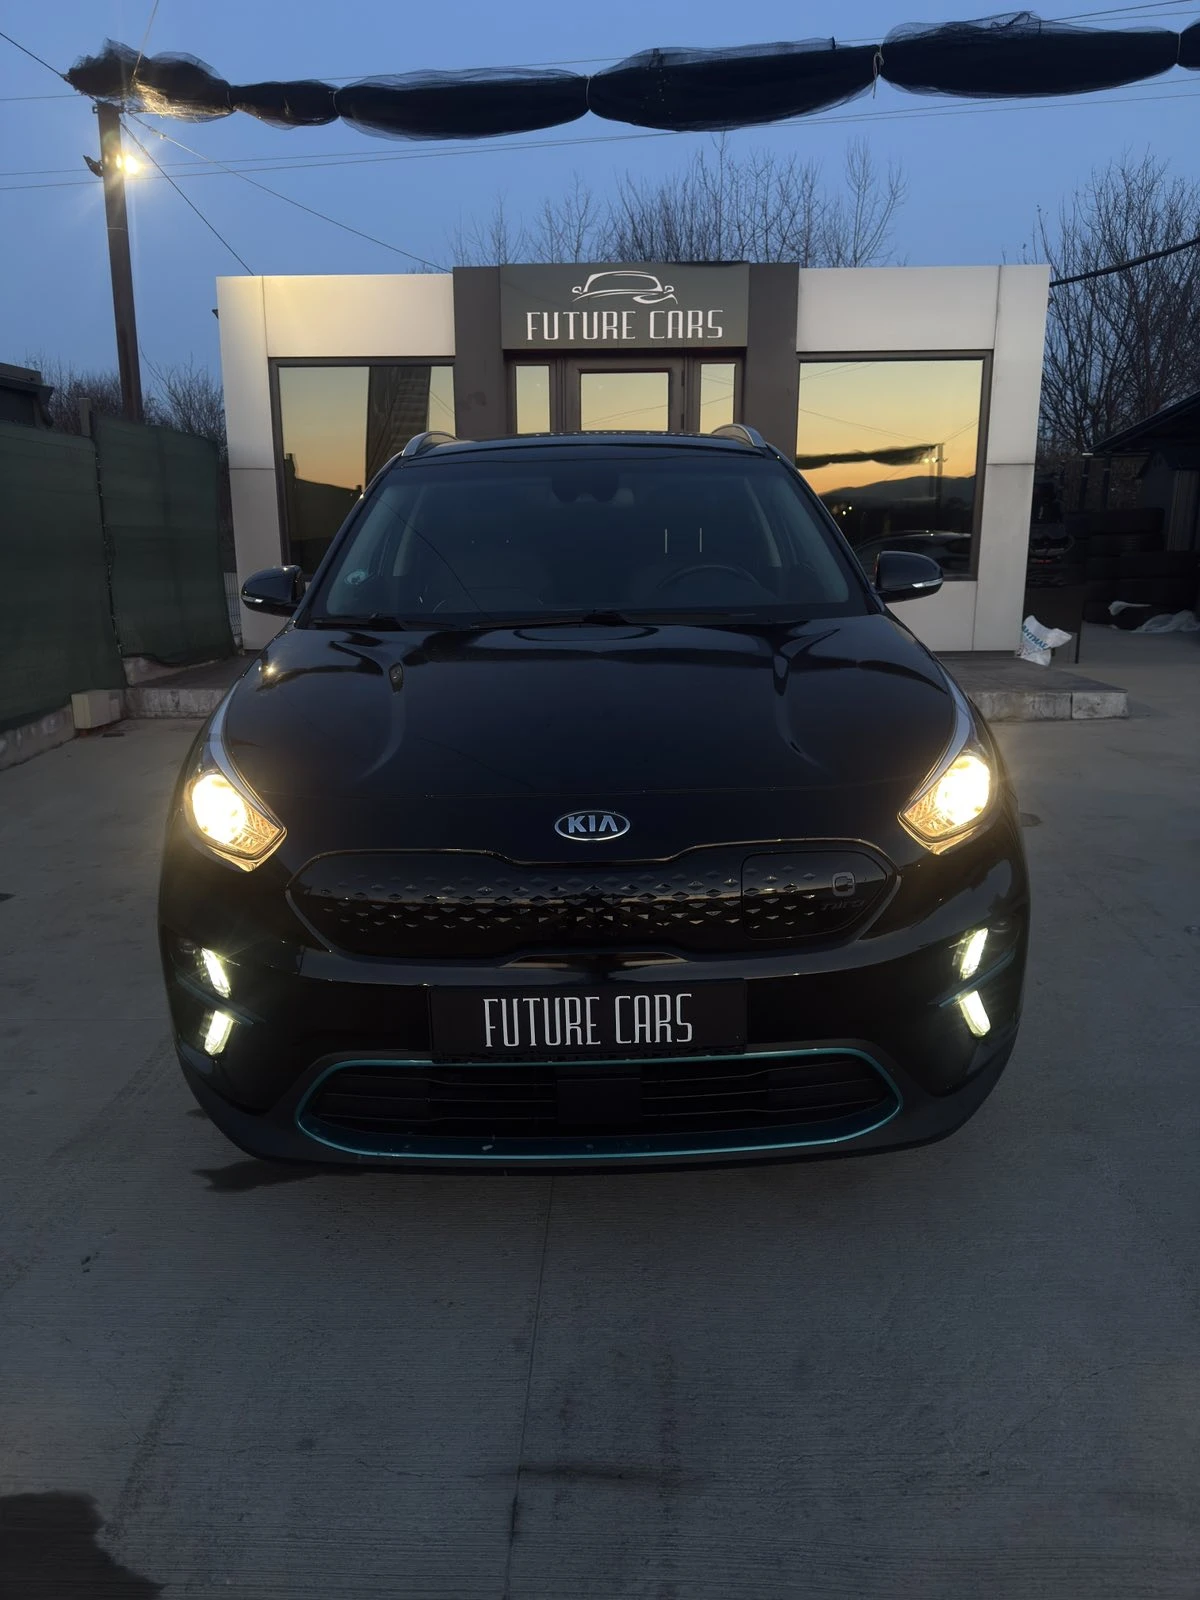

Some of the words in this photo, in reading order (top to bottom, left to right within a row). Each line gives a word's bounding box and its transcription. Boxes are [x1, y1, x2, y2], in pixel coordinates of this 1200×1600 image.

[526, 311, 636, 340] FUTURE
[649, 310, 724, 339] CARS
[568, 815, 618, 833] KIA
[483, 996, 601, 1047] FUTURE
[614, 994, 694, 1045] CARS
